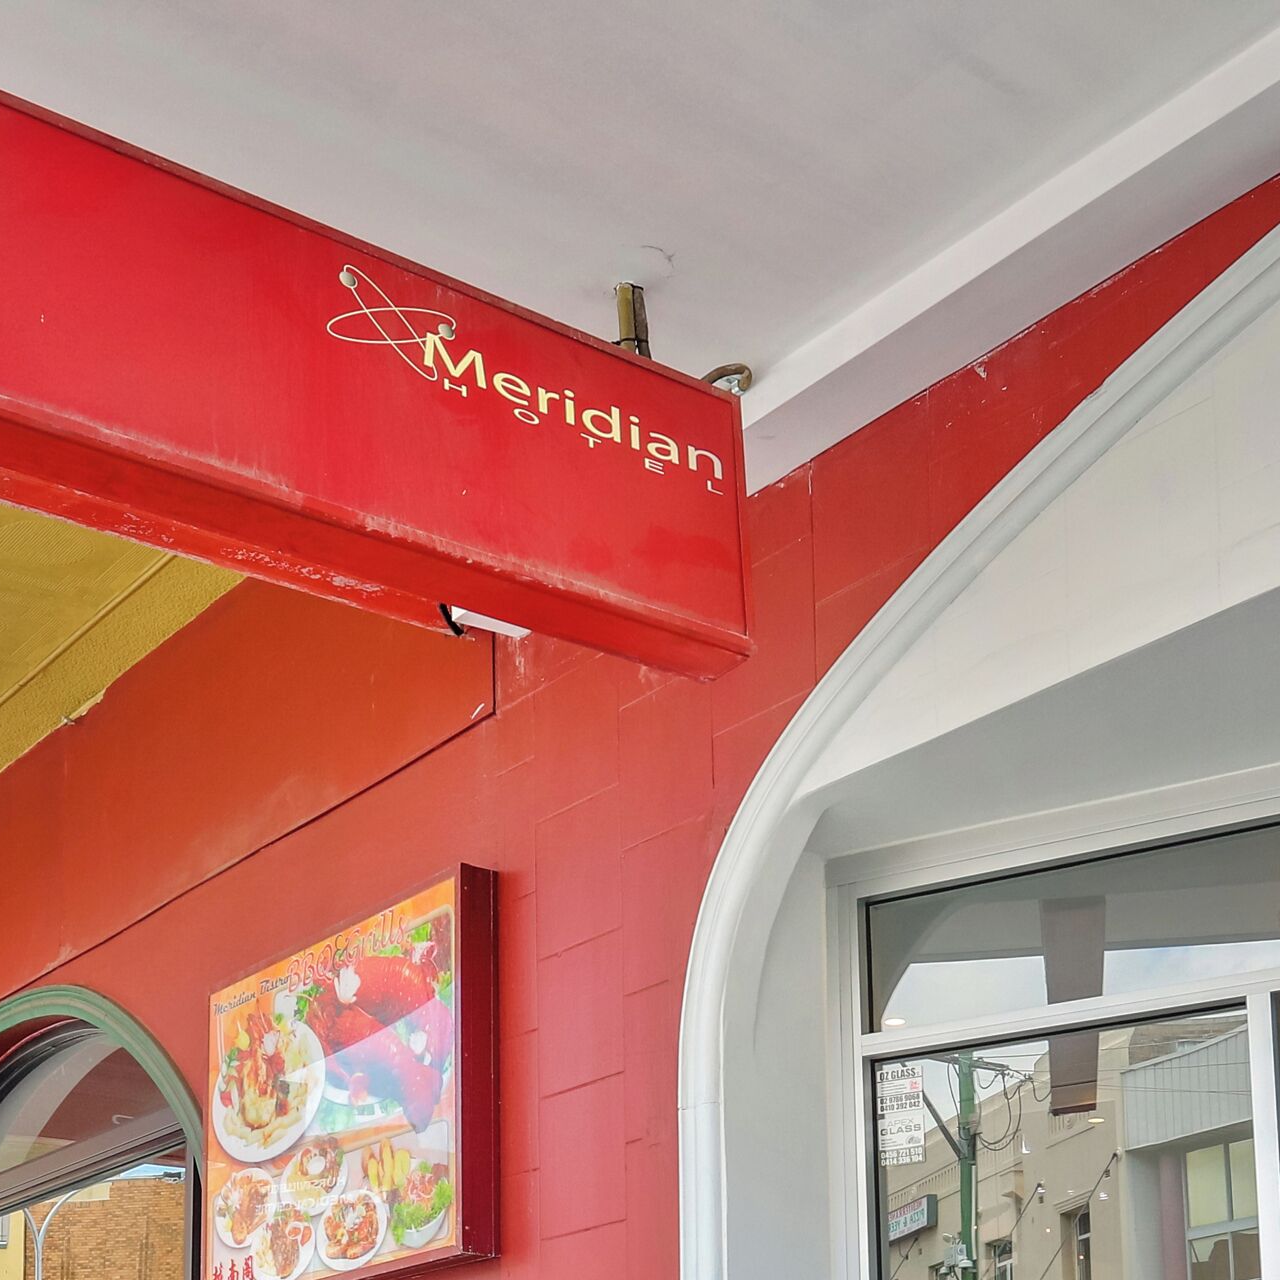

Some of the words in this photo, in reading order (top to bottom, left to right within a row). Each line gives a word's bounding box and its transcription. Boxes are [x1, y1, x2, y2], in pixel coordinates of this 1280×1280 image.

[423, 332, 724, 480] Meridian
[443, 378, 724, 496] HOTEL
[213, 991, 257, 1016] Meridian
[890, 1067, 917, 1080] GLASS
[880, 1123, 921, 1136] GLASS
[887, 1118, 914, 1127] APEX
